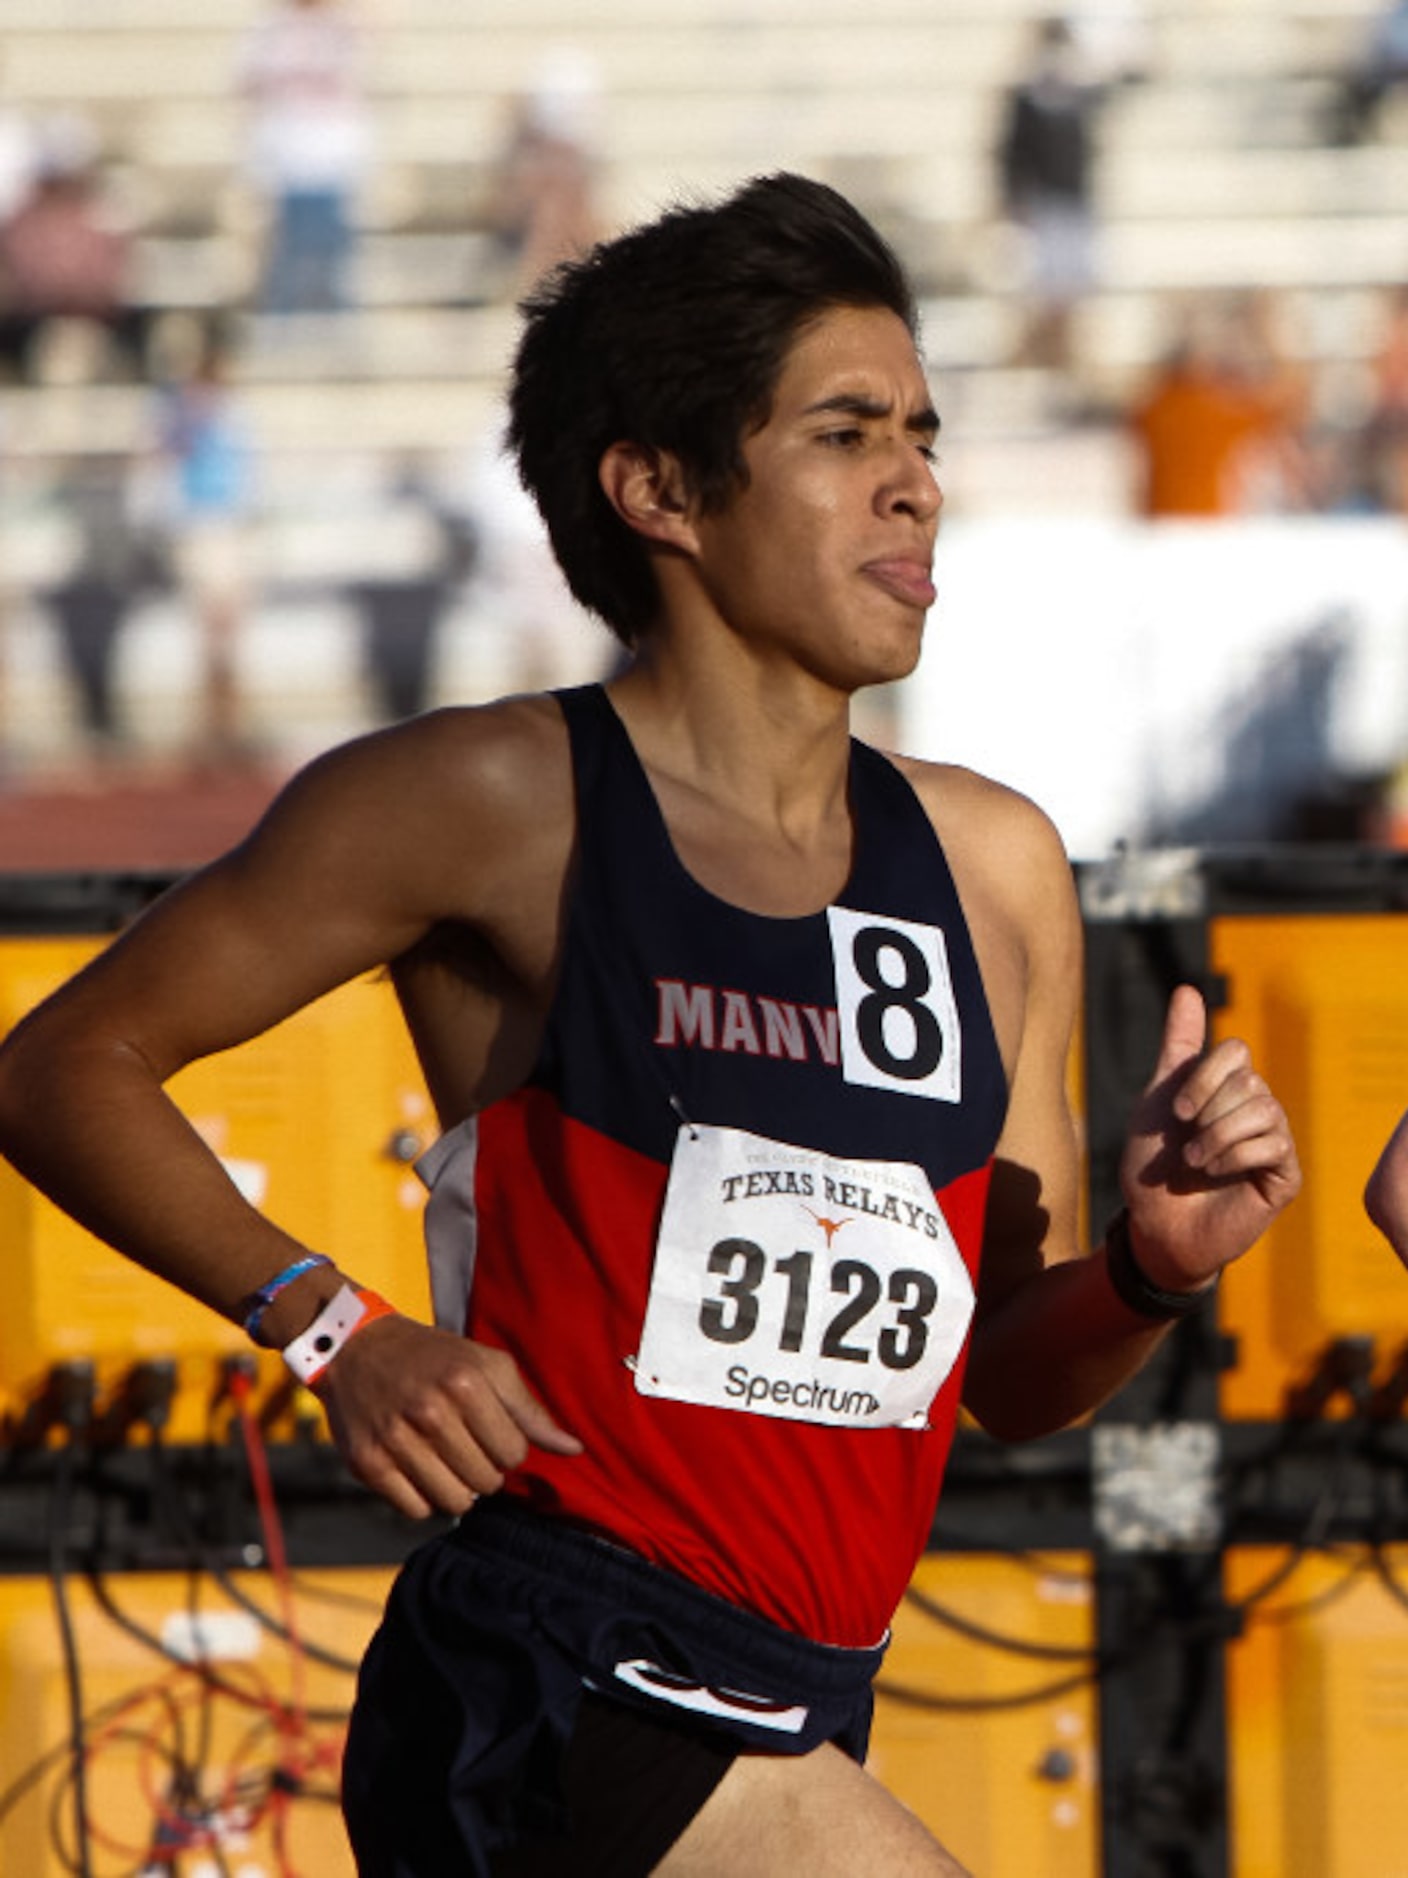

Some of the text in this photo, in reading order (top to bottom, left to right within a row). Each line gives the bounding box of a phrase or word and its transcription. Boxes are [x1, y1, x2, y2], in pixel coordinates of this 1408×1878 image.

[853, 926, 943, 1080] 8
[722, 1170, 815, 1204] TEXAS
[823, 1176, 940, 1239] RELAYS
[699, 1237, 939, 1372] 3123
[725, 1366, 880, 1416] Spectrum
